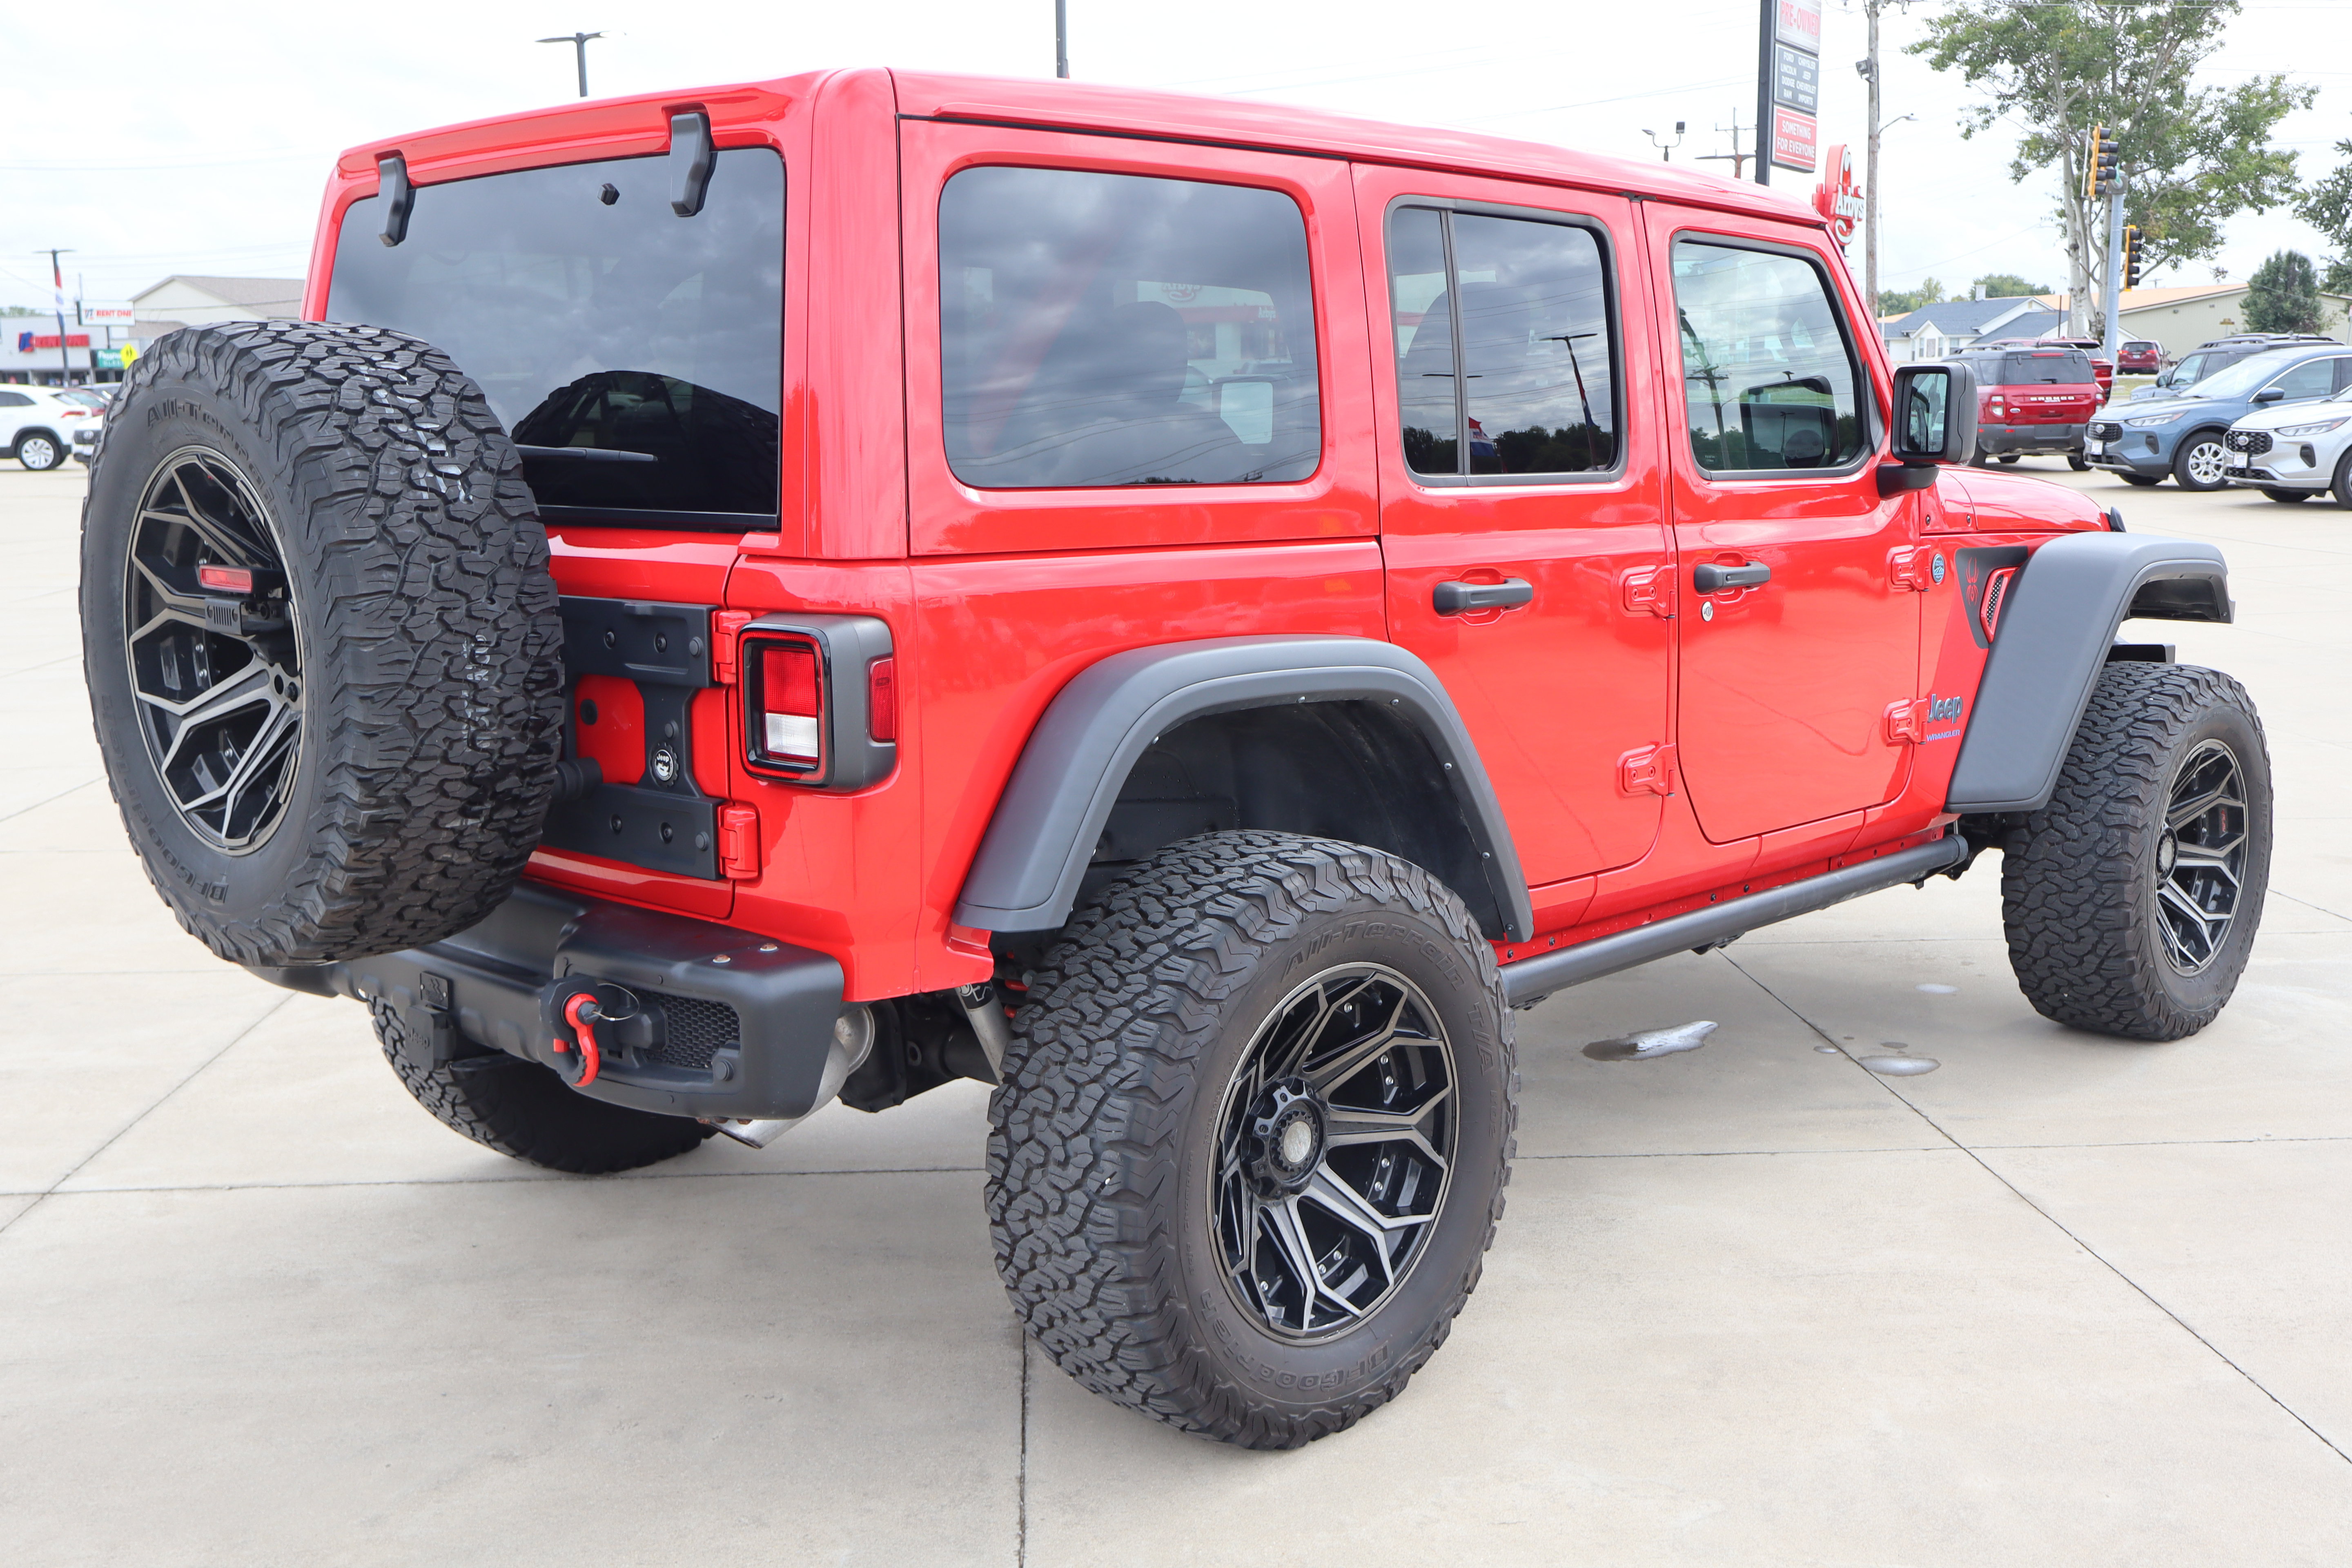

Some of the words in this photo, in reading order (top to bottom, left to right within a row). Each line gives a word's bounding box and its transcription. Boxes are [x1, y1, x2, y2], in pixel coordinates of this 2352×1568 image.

[1780, 1, 1820, 37] PRE-OWNED
[1783, 51, 1794, 63] FORD
[1797, 57, 1816, 71] CHRYSLER
[1780, 63, 1797, 76] LINCOLN
[1802, 71, 1811, 81] JEEP
[1781, 75, 1795, 88] DODGE
[1796, 80, 1816, 95] CHEVROLET
[1783, 89, 1792, 100] RAM
[1798, 94, 1813, 106] IMPORTS
[1782, 120, 1811, 140] SOMETHING
[1777, 136, 1787, 151] FOR
[1790, 139, 1815, 158] EVERYONE
[1927, 694, 1963, 724] Jeep
[1927, 729, 1961, 742] WRANGLER
[657, 753, 669, 763] Jeep
[1281, 920, 1465, 991] All-Terrain
[409, 1028, 430, 1050] Jeep
[1468, 1001, 1493, 1076] T/A
